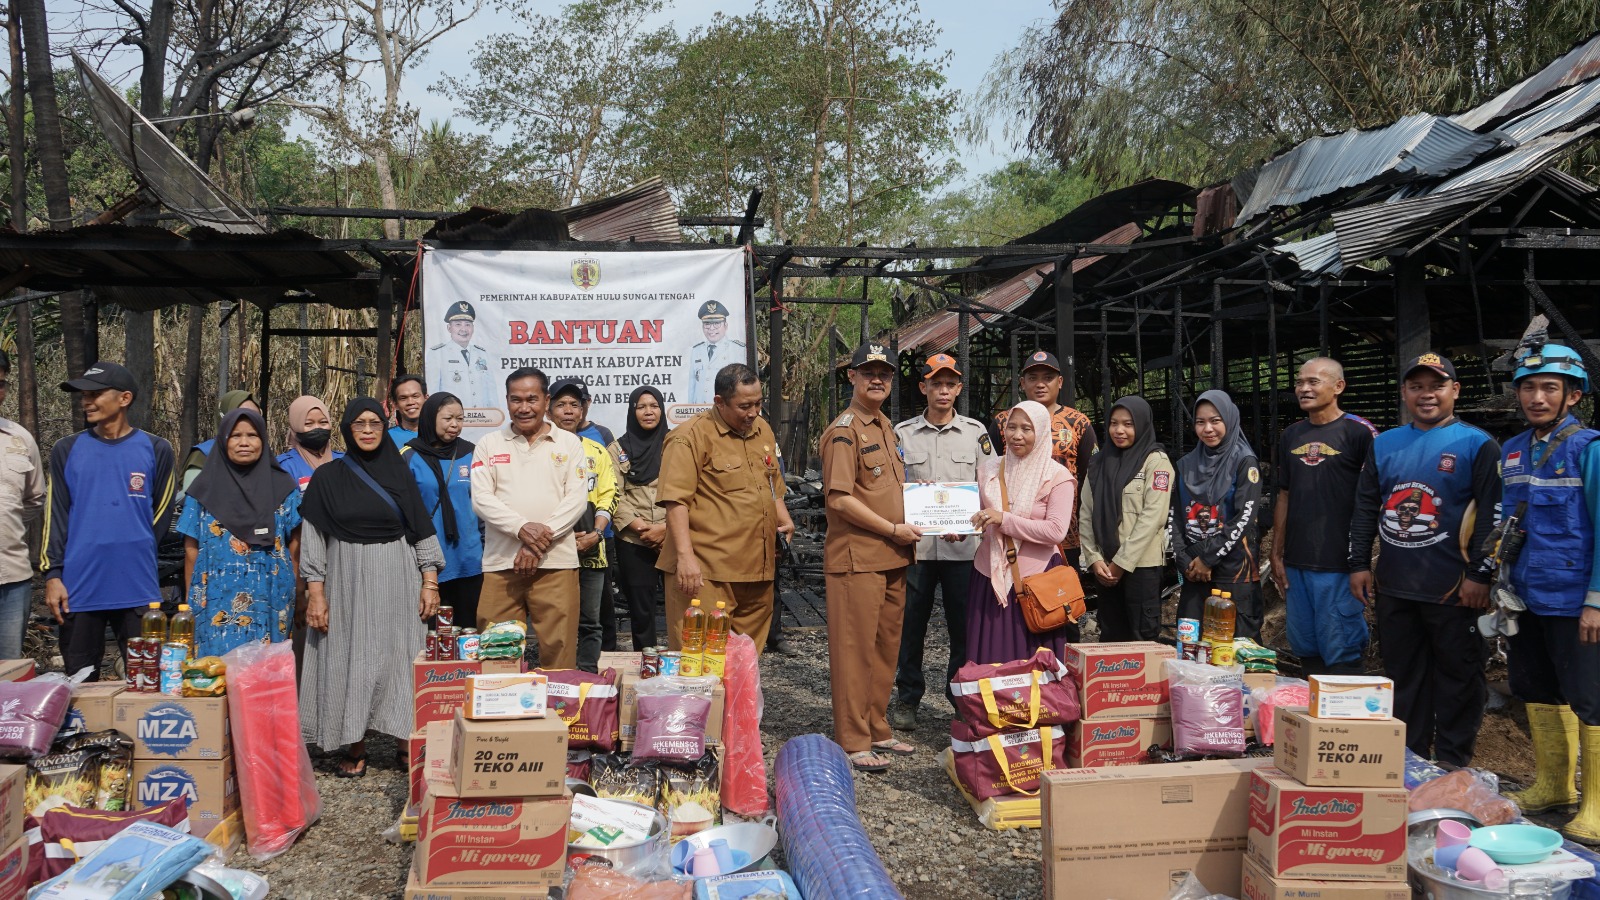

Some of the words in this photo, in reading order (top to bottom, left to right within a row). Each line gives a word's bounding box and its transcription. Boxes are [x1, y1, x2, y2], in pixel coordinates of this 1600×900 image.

[480, 294, 538, 302] PEMERINTAH
[540, 293, 594, 301] KABUPATEN
[596, 293, 621, 301] HULU
[508, 320, 664, 344] BANTUAN
[501, 356, 592, 370] PEMERINTAH
[596, 355, 682, 368] KABUPATEN
[613, 374, 672, 386] TENGAH
[614, 392, 676, 404] BENA
[1089, 659, 1140, 677] Indomie
[1102, 692, 1121, 702] Mi
[1121, 693, 1162, 704] goreng
[433, 704, 454, 714] Mi
[138, 719, 198, 739] MZA
[1086, 726, 1135, 746] Indomie
[1318, 741, 1334, 750] 20
[1338, 743, 1359, 751] cm
[474, 751, 493, 760] 20
[1318, 753, 1355, 763] TEKO
[34, 756, 80, 768] PANDAN
[474, 762, 514, 772] TEKO
[138, 782, 198, 801] MZA
[436, 800, 514, 824] Indomie
[1282, 796, 1356, 820] Indomie
[455, 835, 466, 843] Mi
[468, 835, 495, 843] Instan
[1313, 829, 1338, 838] Instan
[451, 849, 480, 863] Mi
[480, 853, 542, 866] goreng
[1299, 843, 1327, 855] Mi
[1325, 847, 1385, 861] goreng
